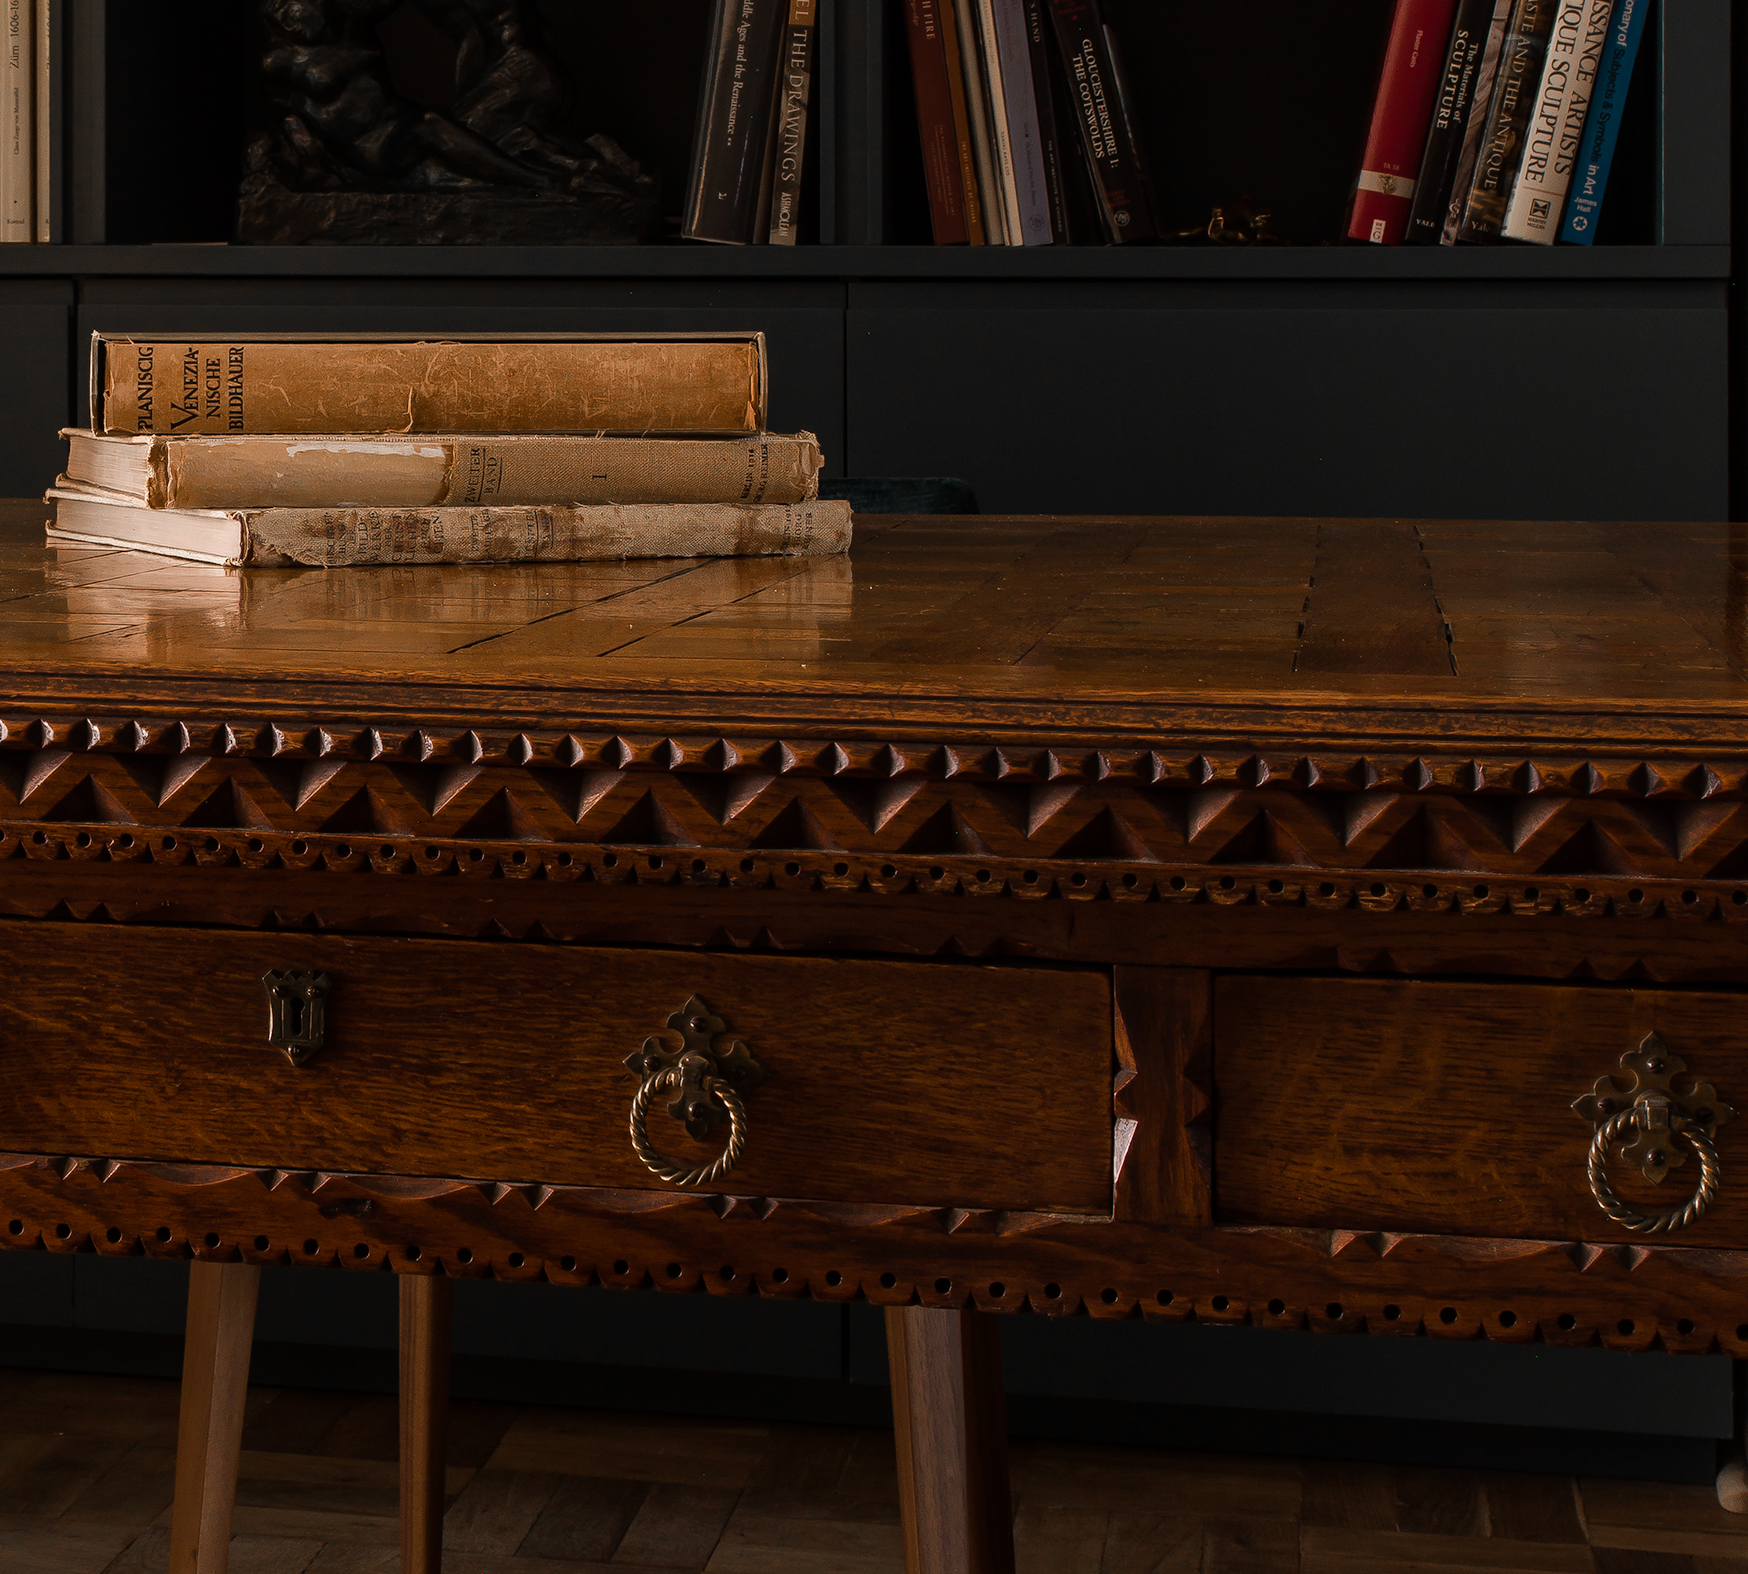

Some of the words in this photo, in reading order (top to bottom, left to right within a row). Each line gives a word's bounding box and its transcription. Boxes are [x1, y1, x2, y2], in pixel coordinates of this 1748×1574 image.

[735, 44, 748, 60] and
[736, 20, 750, 42] Ages
[789, 29, 807, 67] THE
[1465, 43, 1479, 62] The
[1614, 32, 1629, 48] of
[9, 44, 19, 68] Zürn
[733, 64, 746, 78] the
[1070, 53, 1086, 81] THE
[1509, 35, 1532, 73] AND
[1601, 48, 1625, 99] Subjects
[1080, 39, 1118, 156] GLOUCESTERSHIRE
[1436, 29, 1469, 129] SCULPTURE
[1455, 63, 1474, 108] Materials
[1501, 77, 1522, 111] THE
[726, 80, 743, 134] Renaissance
[1077, 83, 1105, 159] COTSWOLDS
[1452, 110, 1463, 123] of
[1523, 59, 1572, 182] SCULPTURE
[1601, 101, 1614, 109] &
[779, 74, 804, 182] DRAWINGS
[1481, 113, 1513, 188] ANTIQUE
[1554, 90, 1589, 175] ARTISTS
[1588, 111, 1612, 163] Symbols
[1582, 176, 1597, 195] Art
[1586, 164, 1600, 175] in
[777, 191, 792, 236] ASHMOLEAN
[137, 346, 154, 430] PLANISCIG
[170, 347, 200, 430] VENEZIA-
[206, 358, 222, 419] NISCHE
[229, 346, 245, 431] BILDHAUER
[465, 447, 481, 502] ZWEITER
